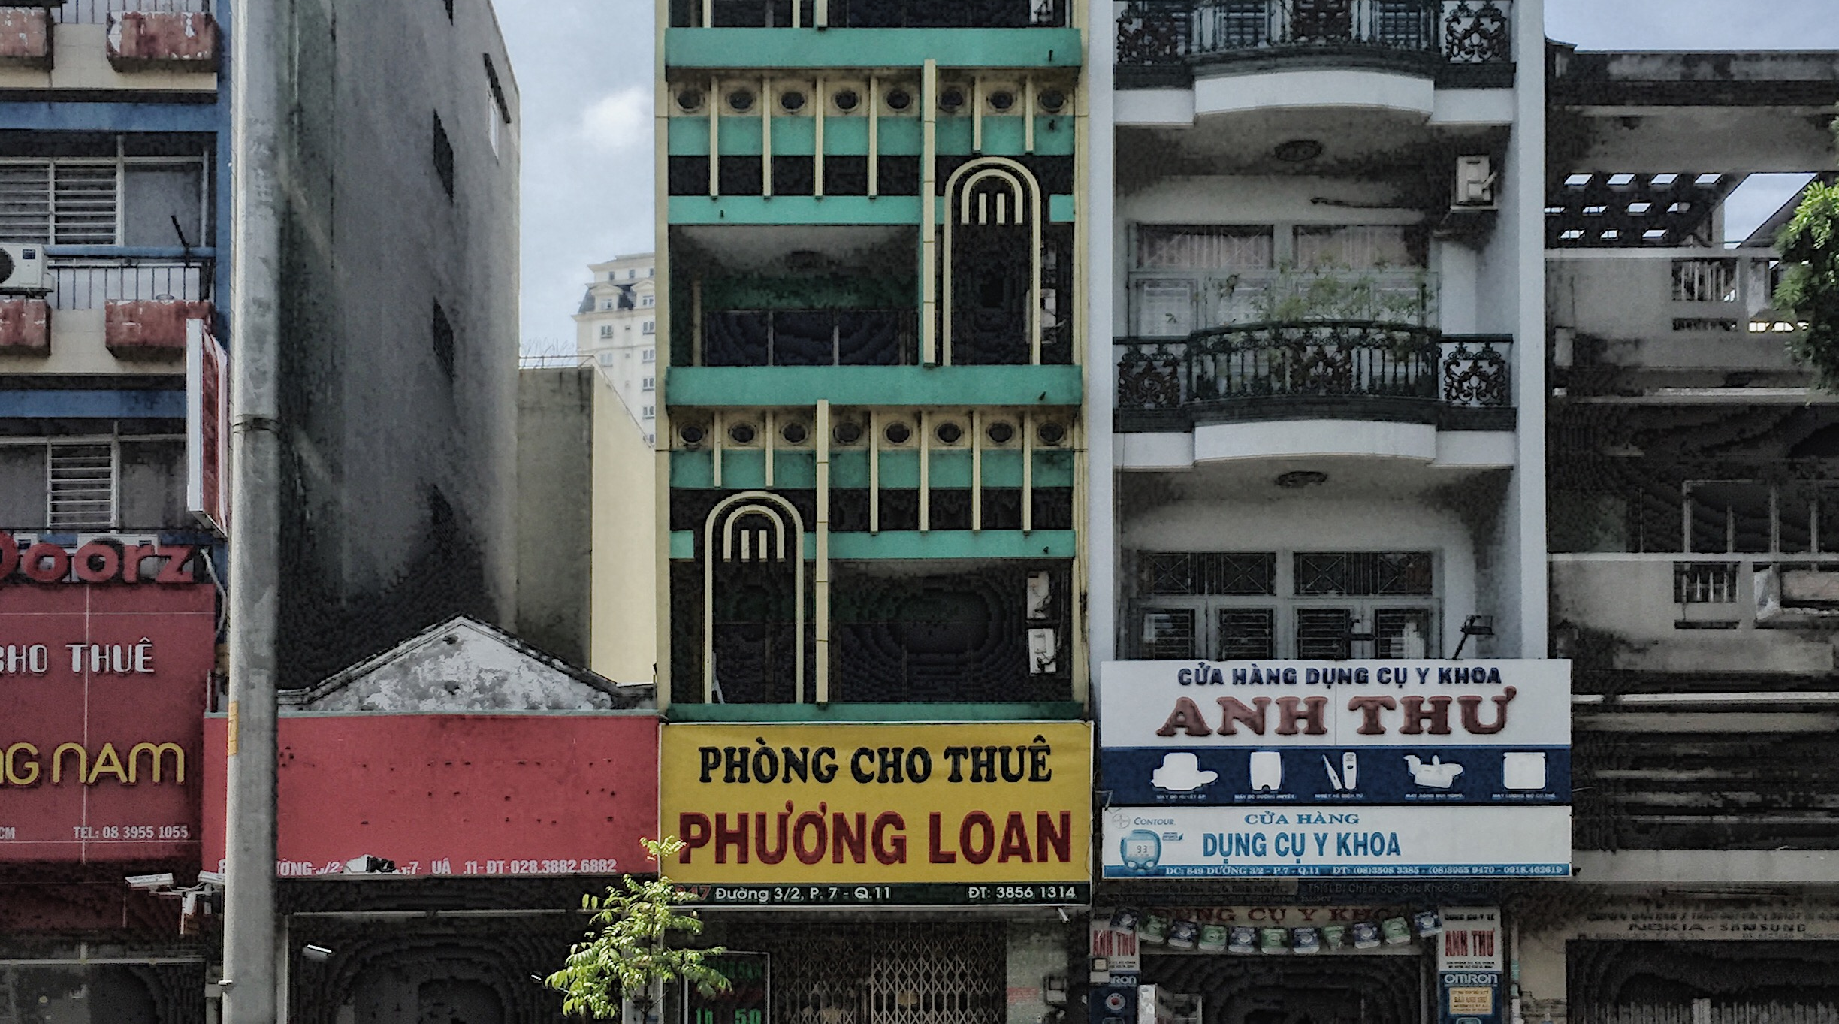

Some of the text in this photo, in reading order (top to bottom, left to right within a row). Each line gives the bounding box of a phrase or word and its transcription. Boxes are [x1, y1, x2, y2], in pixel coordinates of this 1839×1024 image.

[65, 636, 155, 674] THUÊ
[1178, 662, 1503, 689] CỬA HÀNG DỤNG CỤ Y KHOA
[1156, 685, 1518, 737] ANH THƯ
[0, 742, 40, 785] G
[698, 734, 1053, 785] PHÒNG CHO THUÊ
[73, 826, 99, 839] TEL:
[102, 826, 119, 839] 08
[123, 826, 154, 839] 3955
[158, 826, 189, 839] 1055
[679, 799, 1072, 866] PHƯƠNG LOAN
[1244, 810, 1360, 825] CỬA HÀNG
[1202, 831, 1402, 864] DỤNG CỤ Y KHOA
[715, 886, 770, 904] Đường
[774, 887, 805, 901] 3/2,
[810, 887, 823, 900] P.
[829, 887, 838, 900] 7
[854, 886, 891, 900] Q.11
[968, 886, 991, 898] ĐT:
[996, 886, 1034, 898] 3856
[1040, 886, 1076, 898] 1314
[1247, 907, 1287, 924] CỤ
[1298, 908, 1319, 921] Y
